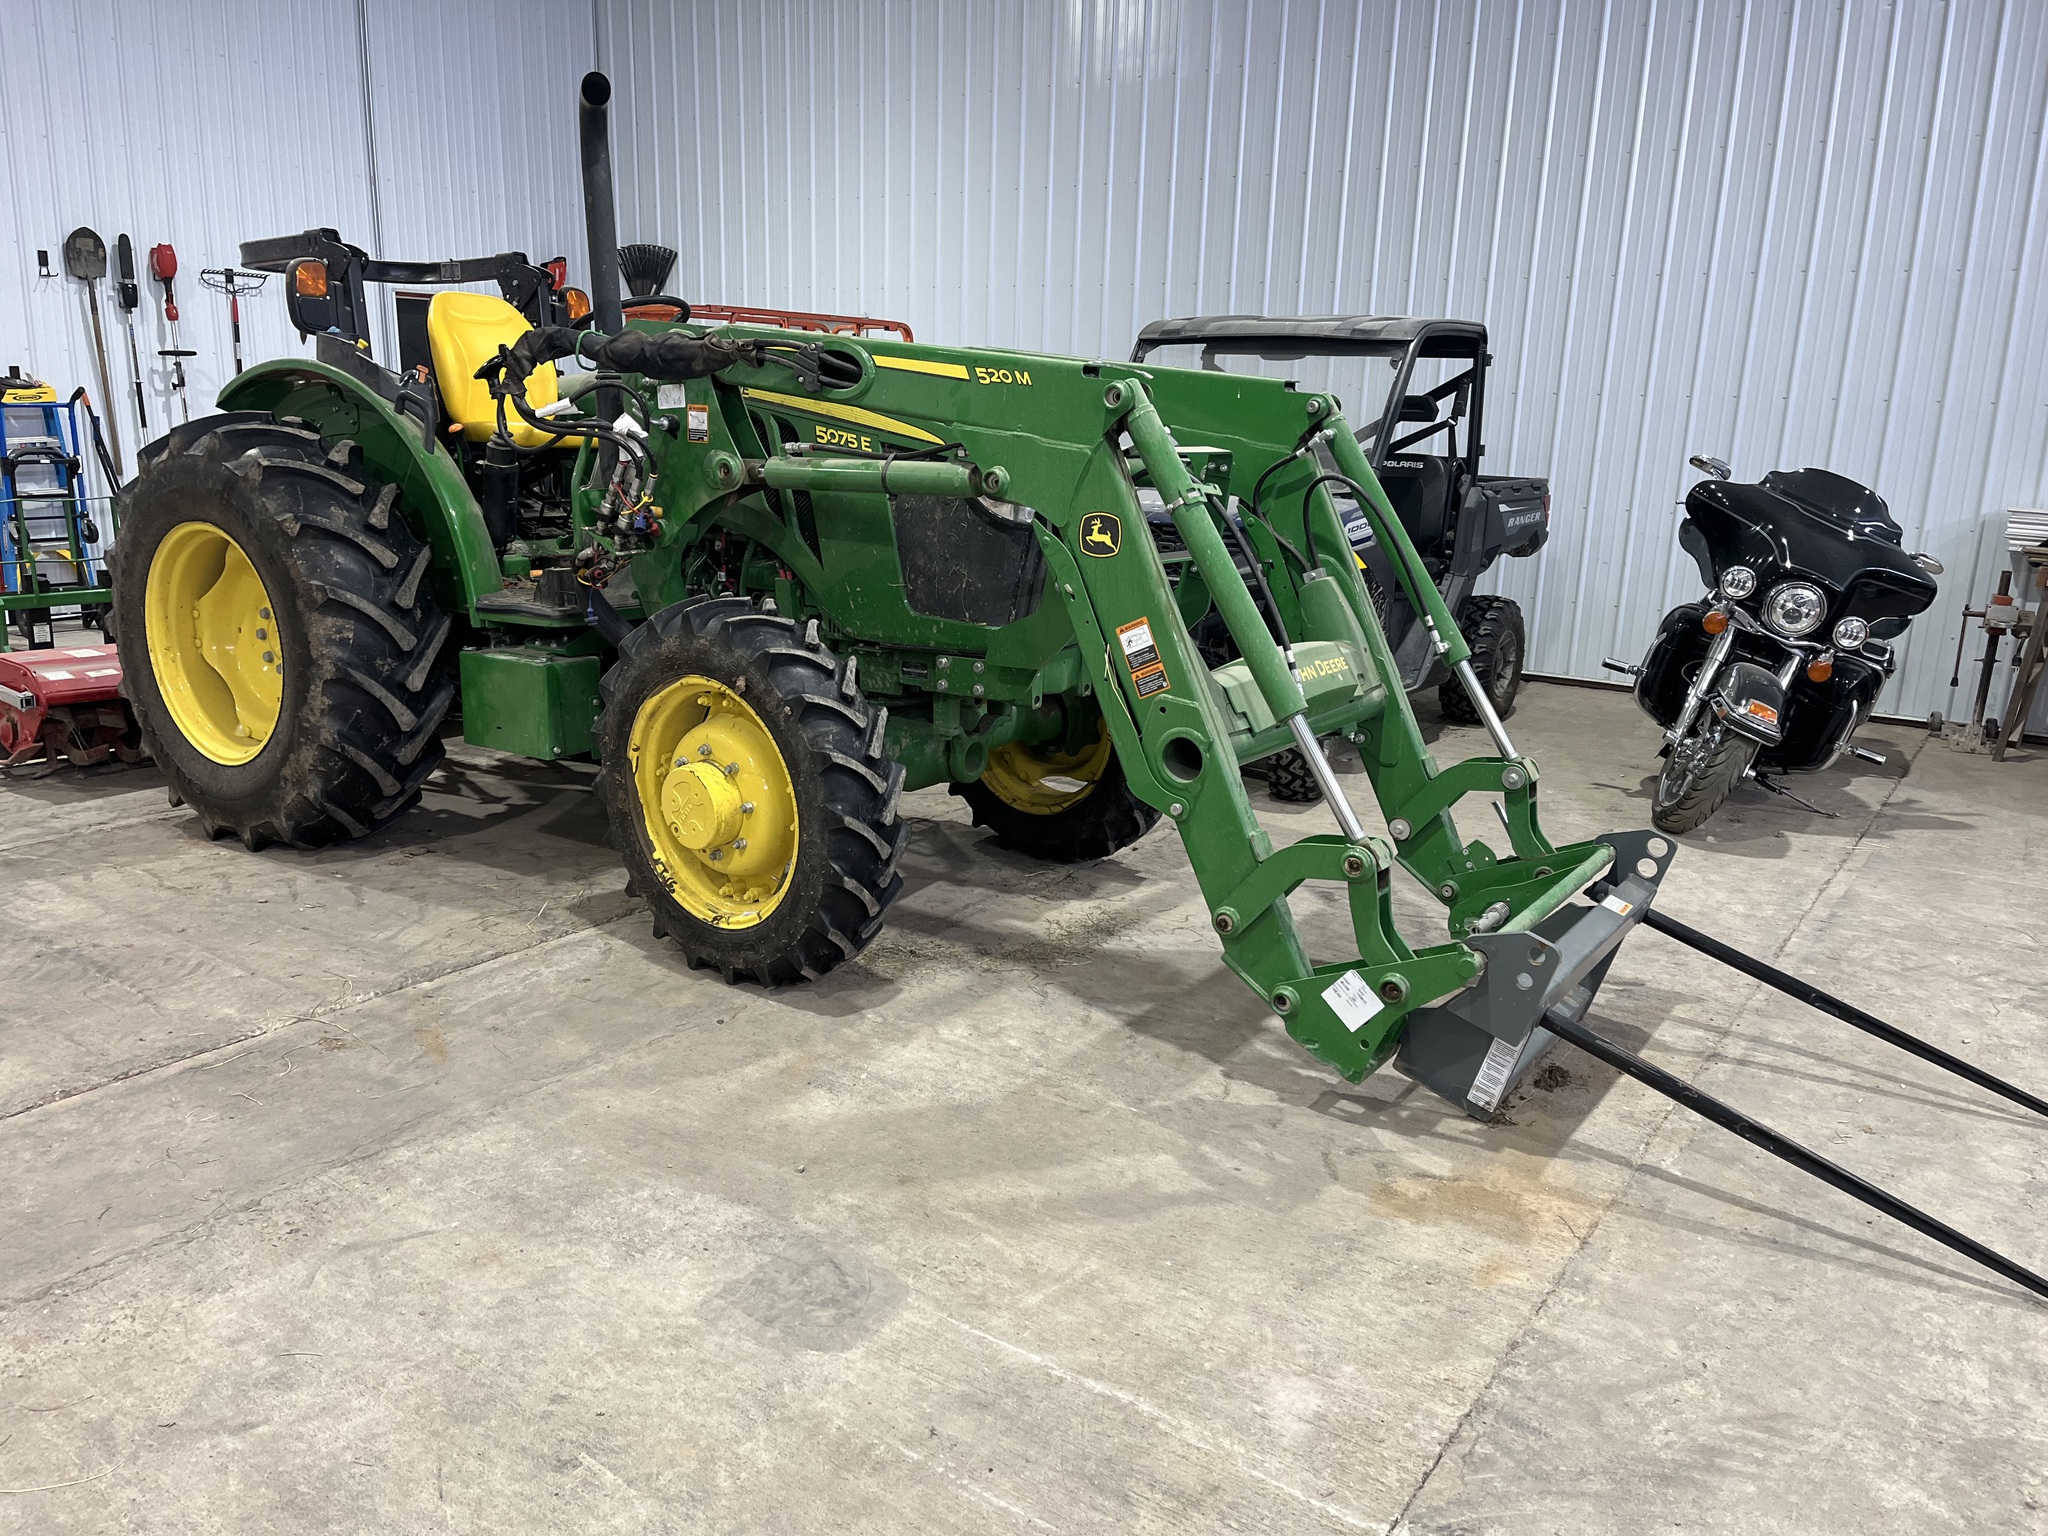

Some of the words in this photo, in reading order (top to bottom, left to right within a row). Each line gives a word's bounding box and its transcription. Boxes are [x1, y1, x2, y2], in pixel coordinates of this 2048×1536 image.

[974, 366, 1013, 385] 520
[1013, 370, 1033, 386] M
[815, 425, 858, 448] 5075
[860, 435, 873, 453] E
[1347, 521, 1370, 534] 100
[1507, 511, 1541, 528] RANGER
[1298, 664, 1318, 681] HN
